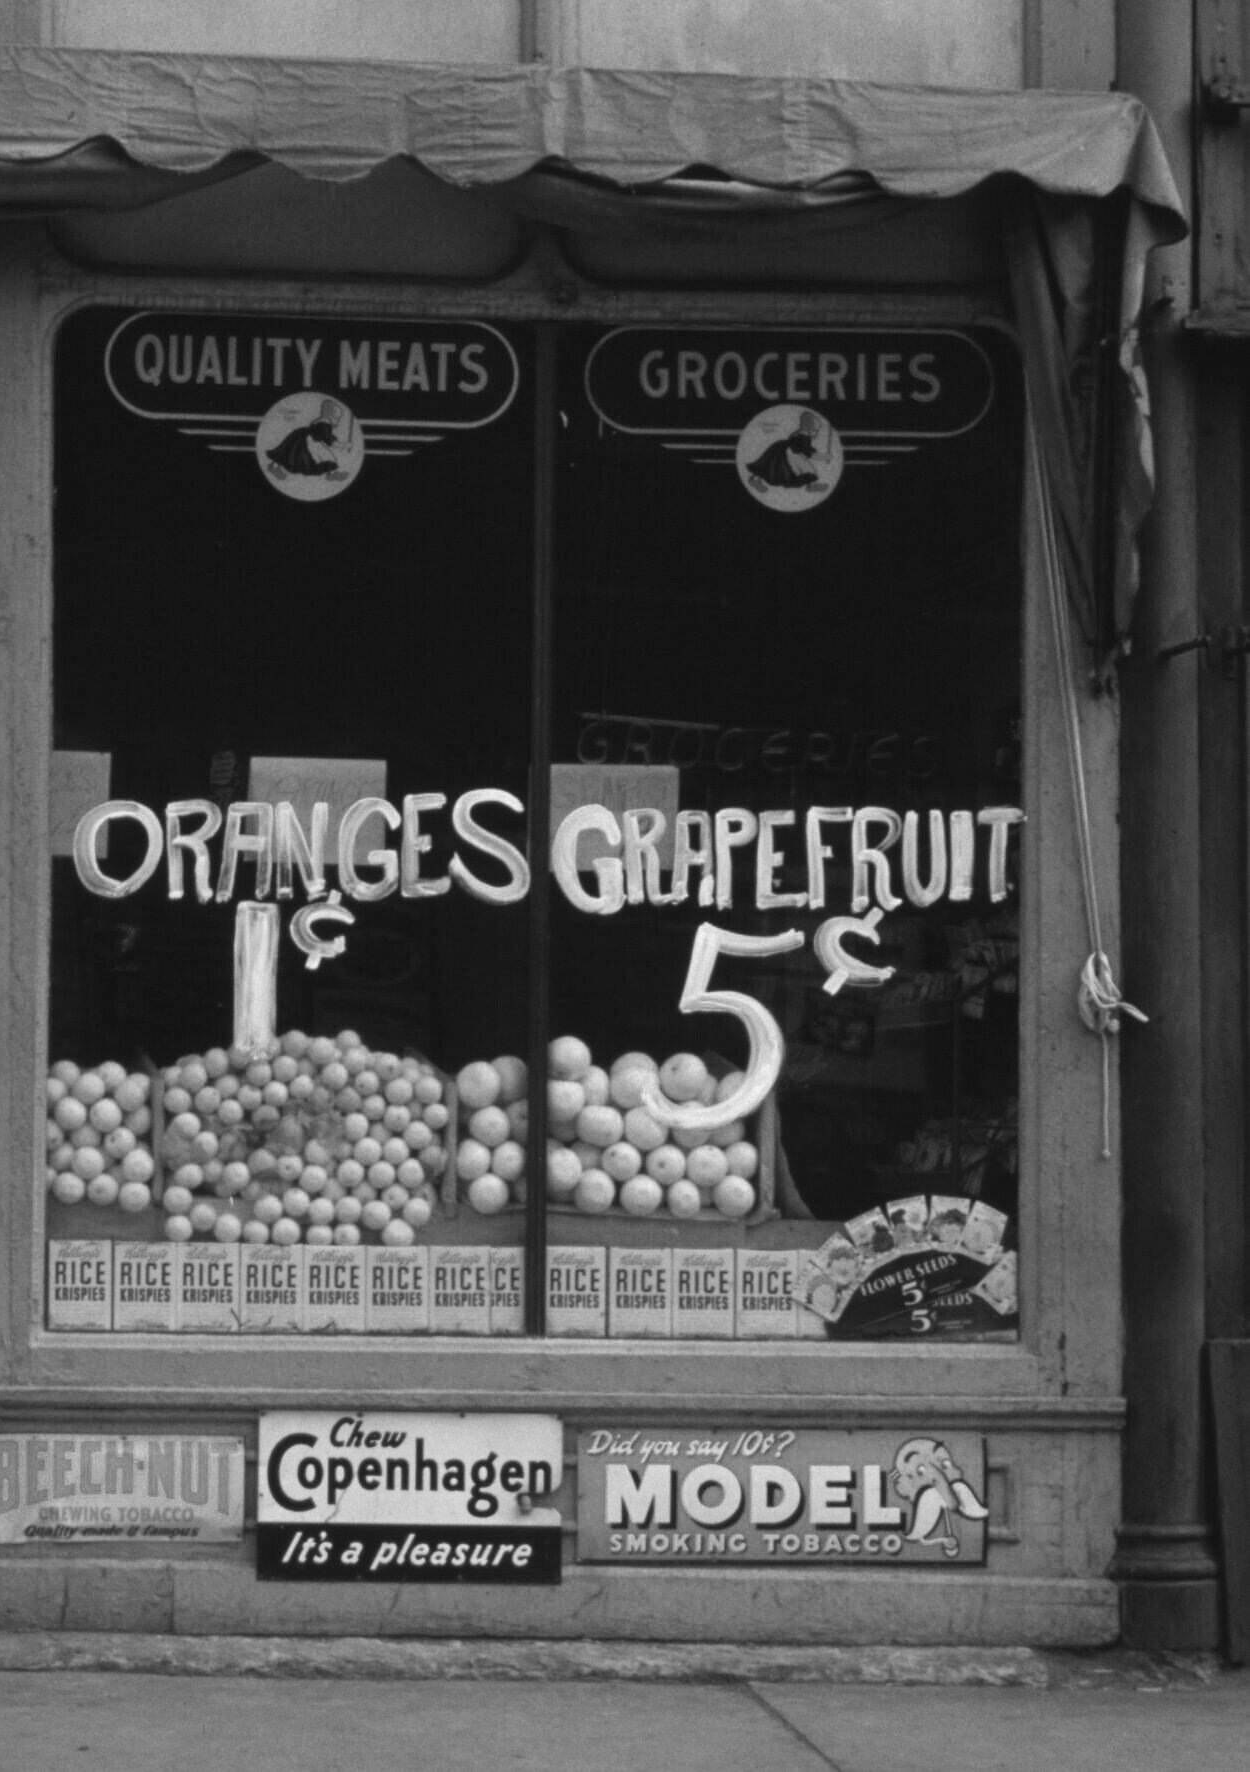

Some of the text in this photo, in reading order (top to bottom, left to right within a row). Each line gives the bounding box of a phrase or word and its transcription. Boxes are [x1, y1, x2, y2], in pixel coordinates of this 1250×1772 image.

[134, 334, 488, 393] QUALITY MEATS
[639, 351, 941, 402] GROCERIES
[72, 788, 531, 906] ORANGES
[552, 803, 1028, 915] GRAPEFRUIT
[54, 1261, 106, 1285] RICE
[120, 1262, 171, 1286] RICE
[182, 1263, 234, 1287] RICE
[246, 1264, 297, 1288] RICE
[309, 1265, 360, 1289] RICE
[372, 1266, 423, 1290] RICE
[435, 1266, 486, 1291] RICE
[494, 1267, 520, 1291] CE
[549, 1268, 600, 1293] RICE
[615, 1268, 667, 1293] RICE
[678, 1269, 730, 1294] RICE
[742, 1270, 793, 1295] RICE
[54, 1287, 106, 1301] KRISPIES
[120, 1288, 171, 1303] KRISPIES
[182, 1288, 234, 1303] KRISPIES
[246, 1289, 297, 1305] KRISPIES
[309, 1291, 360, 1306] KRISPIES
[372, 1292, 423, 1307] KRISPIES
[435, 1292, 486, 1308] KRISPIES
[549, 1294, 600, 1309] KRISPIES
[615, 1294, 667, 1310] KRISPIES
[678, 1295, 730, 1311] KRISPIES
[742, 1296, 793, 1312] KRISPIES
[329, 1416, 407, 1448] Chew
[586, 1430, 641, 1456] Did
[640, 1438, 681, 1464] you
[685, 1438, 729, 1463] say
[267, 1432, 552, 1518] Copenhagen
[605, 1462, 903, 1528] MODEL
[38, 1506, 195, 1523] CHEWING TOBACCO
[282, 1531, 533, 1571] It's a pleasure
[608, 1532, 903, 1555] SMOKING TOBACCO
